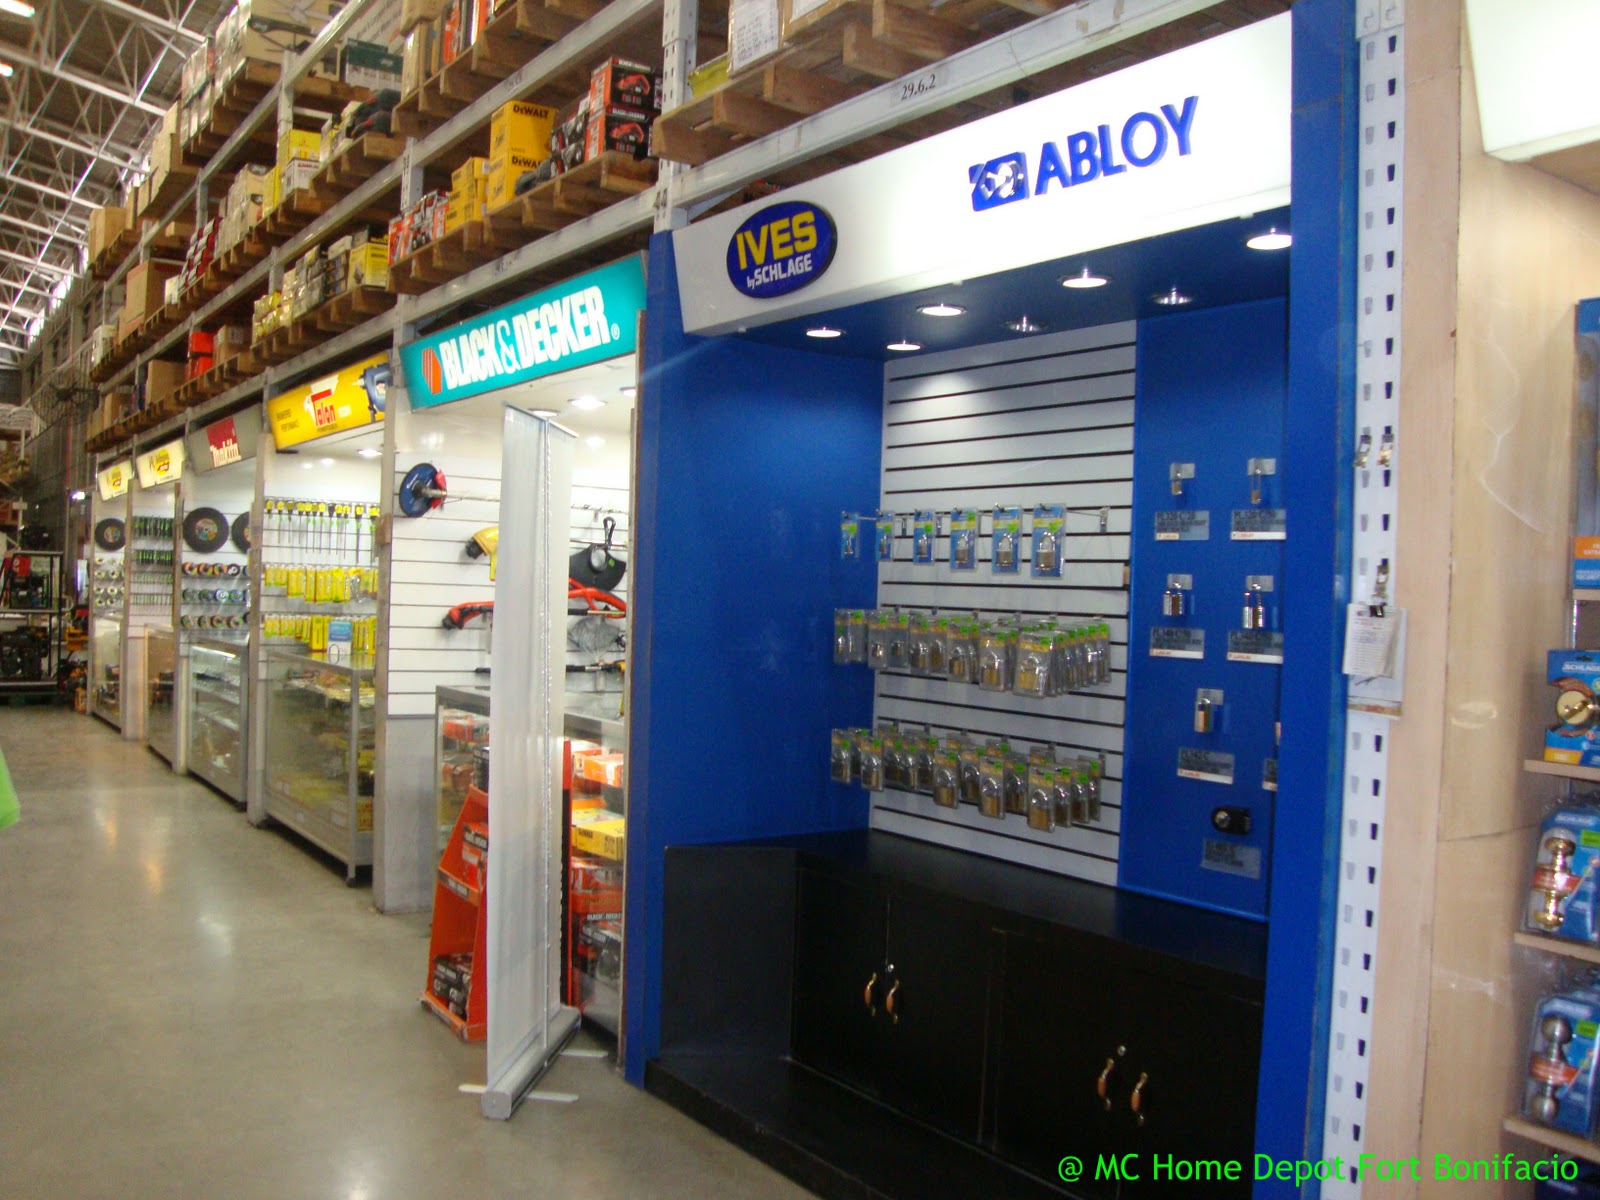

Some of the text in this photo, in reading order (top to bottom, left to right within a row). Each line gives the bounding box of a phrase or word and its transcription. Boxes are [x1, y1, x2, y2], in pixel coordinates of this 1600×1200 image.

[900, 74, 936, 100] 29.6.2
[1034, 95, 1199, 196] ABLOY
[736, 210, 817, 270] IVES
[754, 253, 813, 286] SCHLAGE
